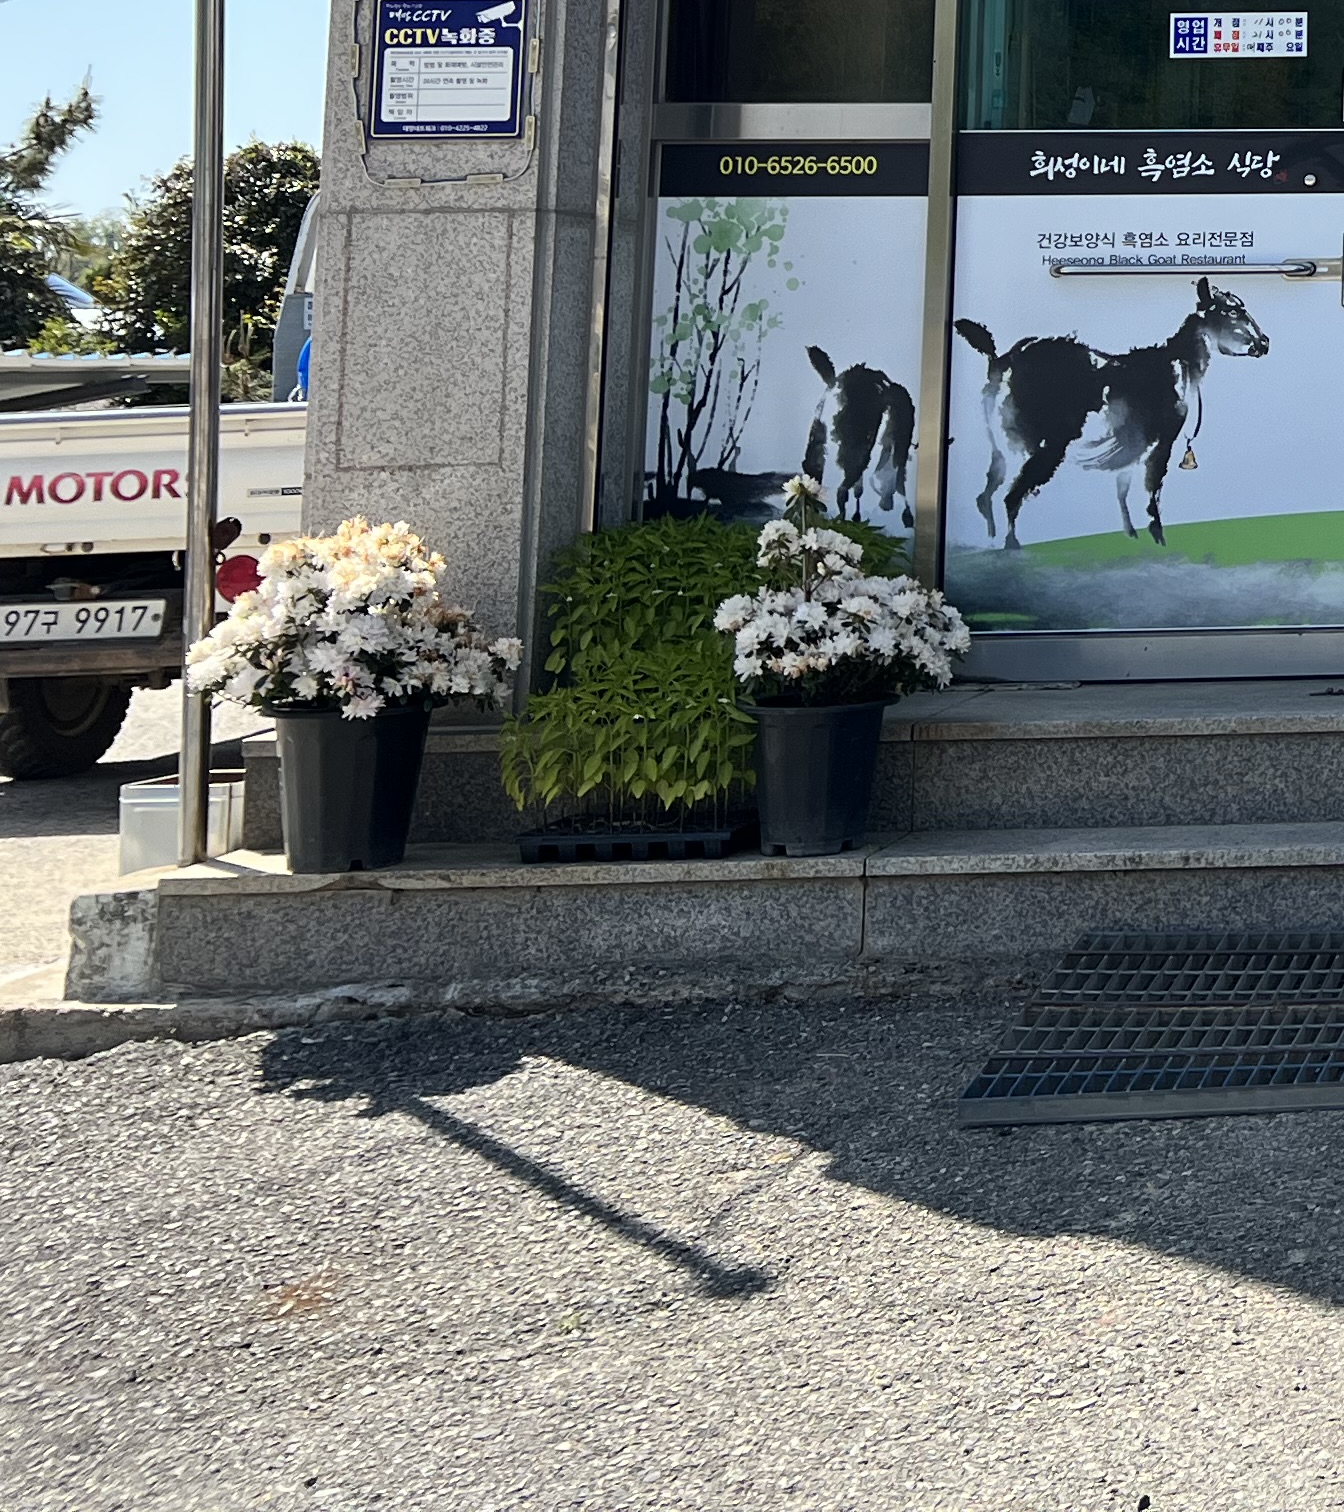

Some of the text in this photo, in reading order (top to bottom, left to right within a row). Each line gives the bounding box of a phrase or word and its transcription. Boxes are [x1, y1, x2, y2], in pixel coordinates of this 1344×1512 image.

[1176, 19, 1205, 35] 영업
[1176, 36, 1206, 52] 시간
[719, 155, 878, 176] 010-6526-6500
[1029, 149, 1126, 179] 희성이네
[1137, 146, 1216, 180] 흑염소
[1226, 150, 1281, 180] 식당
[1037, 231, 1255, 250] 건강보양식 흑염소 요리전문점
[1042, 253, 1246, 266] Heeseong Black Goat Restaurant
[5, 468, 189, 506] MOTOR
[75, 605, 149, 634] 9917
